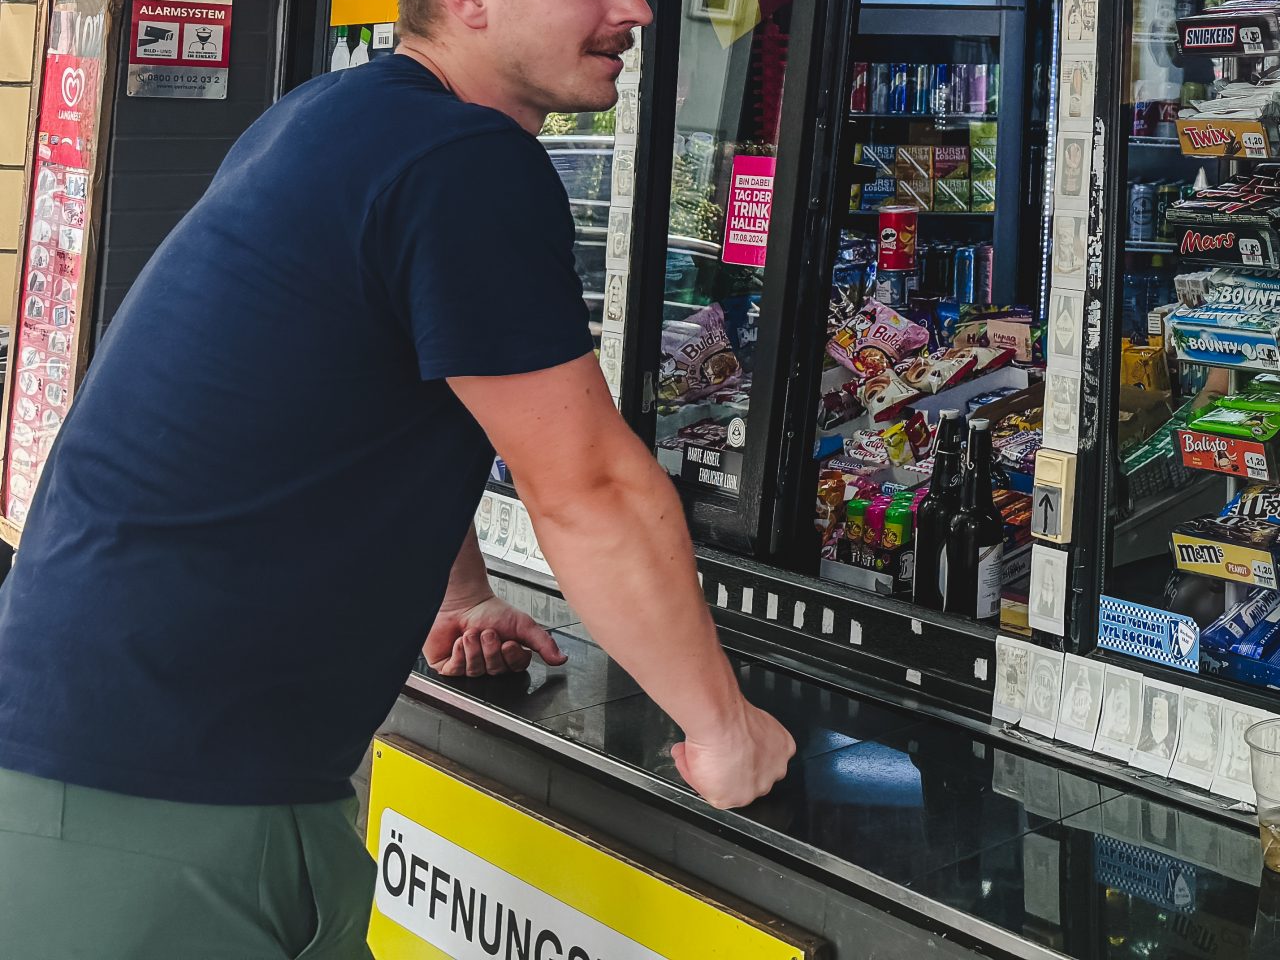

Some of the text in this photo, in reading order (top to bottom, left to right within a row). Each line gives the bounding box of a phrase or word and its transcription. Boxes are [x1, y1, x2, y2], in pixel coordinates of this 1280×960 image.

[139, 5, 226, 20] ALARMSYSTEM
[1185, 27, 1235, 45] SNICKERS
[147, 74, 171, 82] 0800
[173, 74, 185, 82] 01
[186, 75, 198, 83] 02
[1184, 123, 1231, 148] Twix
[738, 177, 770, 187] BIN DABEI
[735, 189, 771, 203] TAG DER
[733, 201, 770, 218] TRINK
[730, 217, 769, 232] HALLEN
[733, 233, 764, 243] 17.08.2024
[1180, 229, 1235, 254] Mars
[1189, 336, 1236, 354] BOUNTY
[1184, 433, 1228, 452] Balisto
[1228, 564, 1248, 574] PEANUT
[1102, 610, 1127, 626] IMMER
[1121, 628, 1164, 651] BOCHUM
[382, 829, 602, 960] ÖFFNUNG
